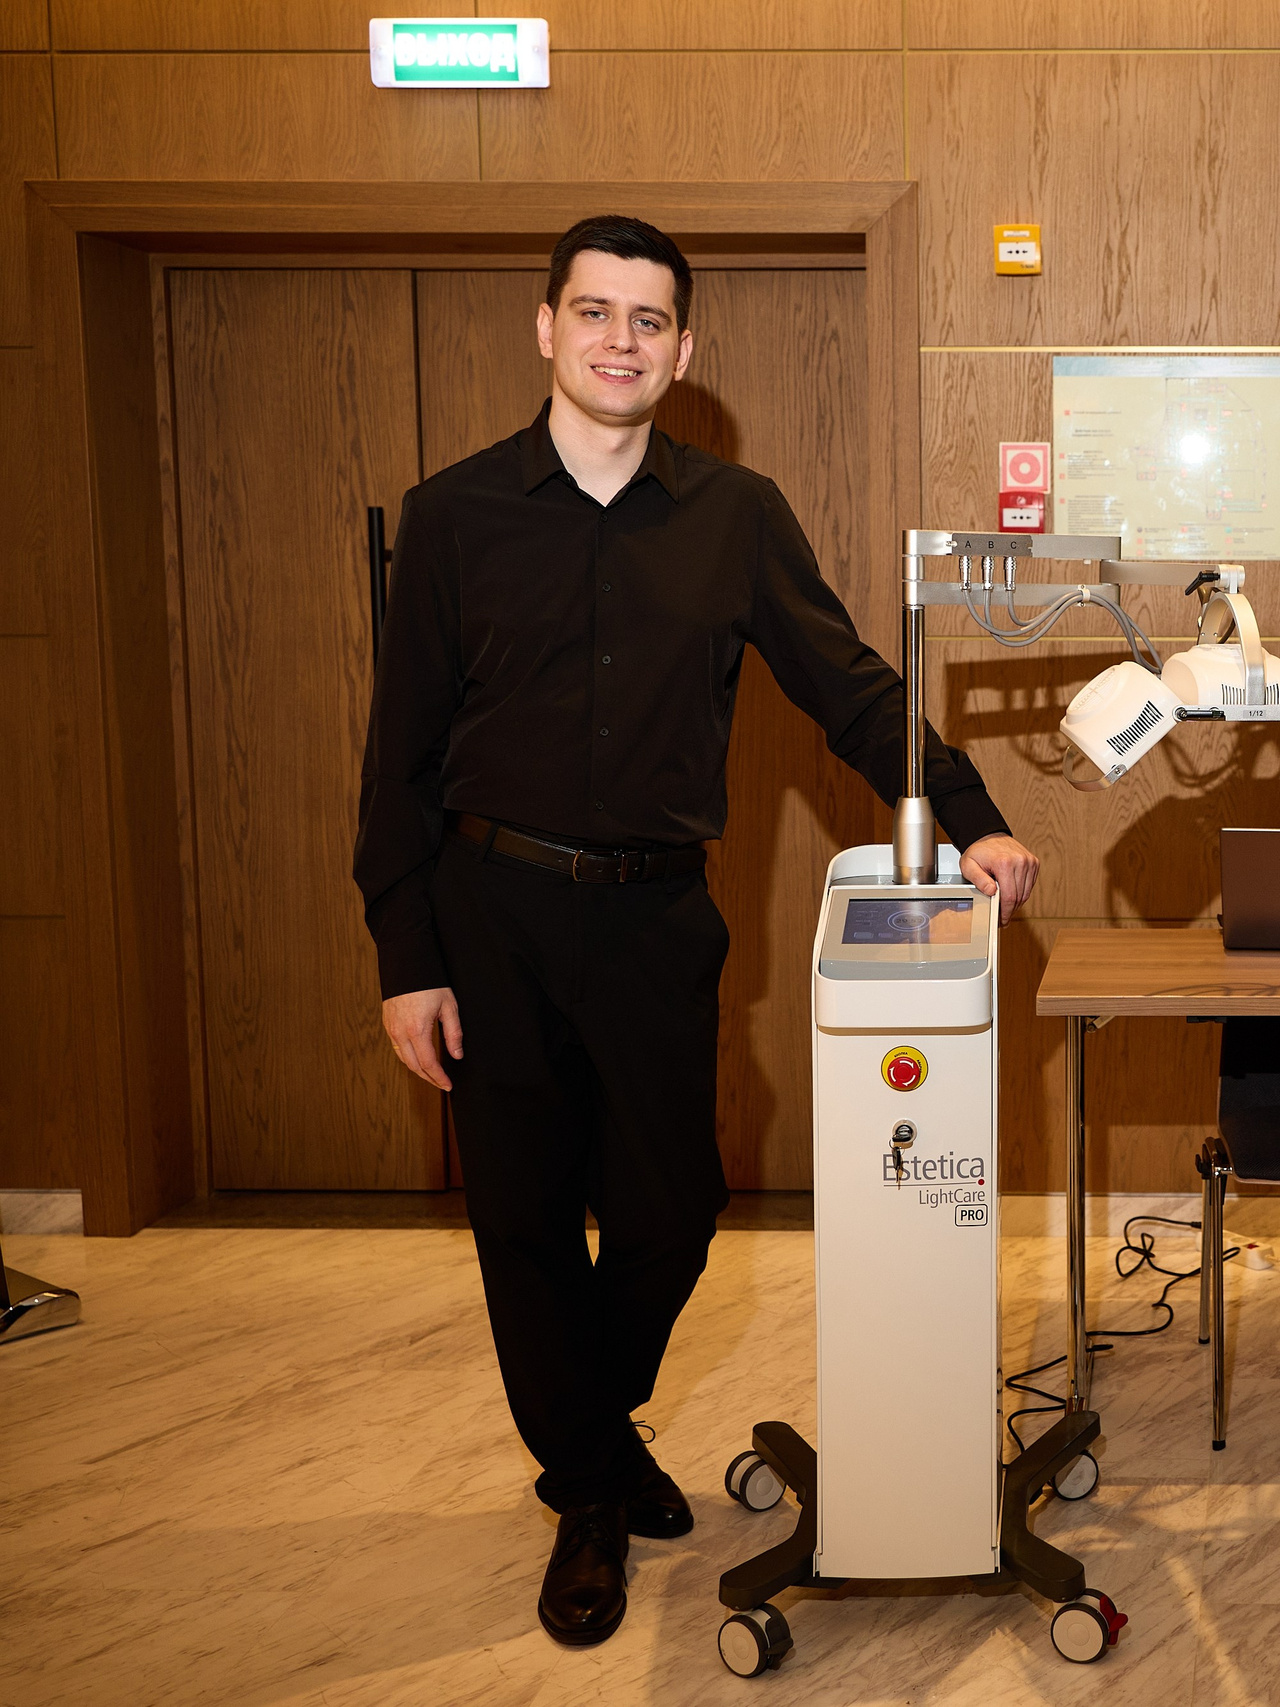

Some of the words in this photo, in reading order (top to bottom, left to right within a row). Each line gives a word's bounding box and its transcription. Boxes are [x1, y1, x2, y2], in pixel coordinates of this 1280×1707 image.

[395, 32, 515, 73] ВЫХОД
[964, 540, 972, 549] A
[988, 541, 995, 550] B
[1010, 541, 1017, 550] C
[1248, 710, 1263, 718] 1/12
[882, 1151, 985, 1181] Estetica
[919, 1188, 986, 1208] LightCare
[960, 1209, 984, 1221] PRO
